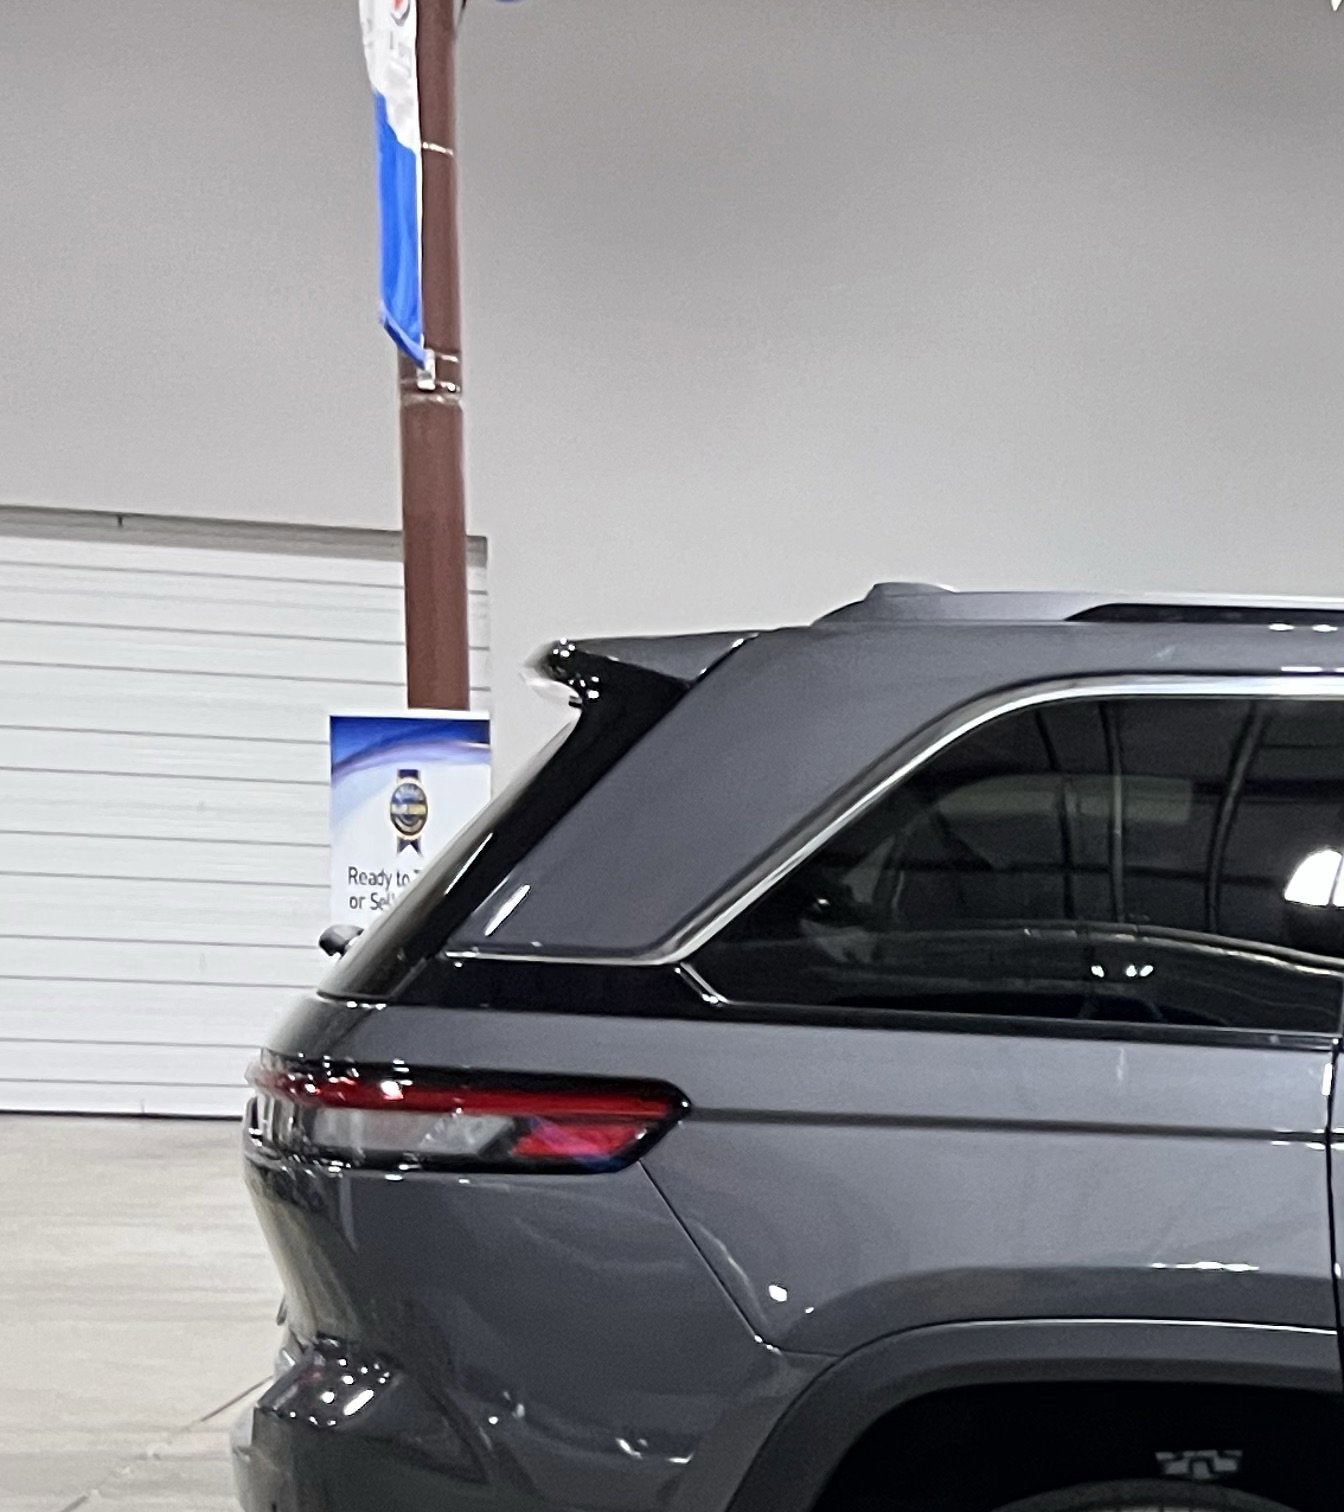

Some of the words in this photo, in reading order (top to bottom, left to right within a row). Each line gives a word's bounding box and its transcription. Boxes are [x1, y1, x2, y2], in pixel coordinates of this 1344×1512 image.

[347, 866, 392, 892] Ready
[396, 870, 411, 887] to
[349, 895, 366, 910] or
